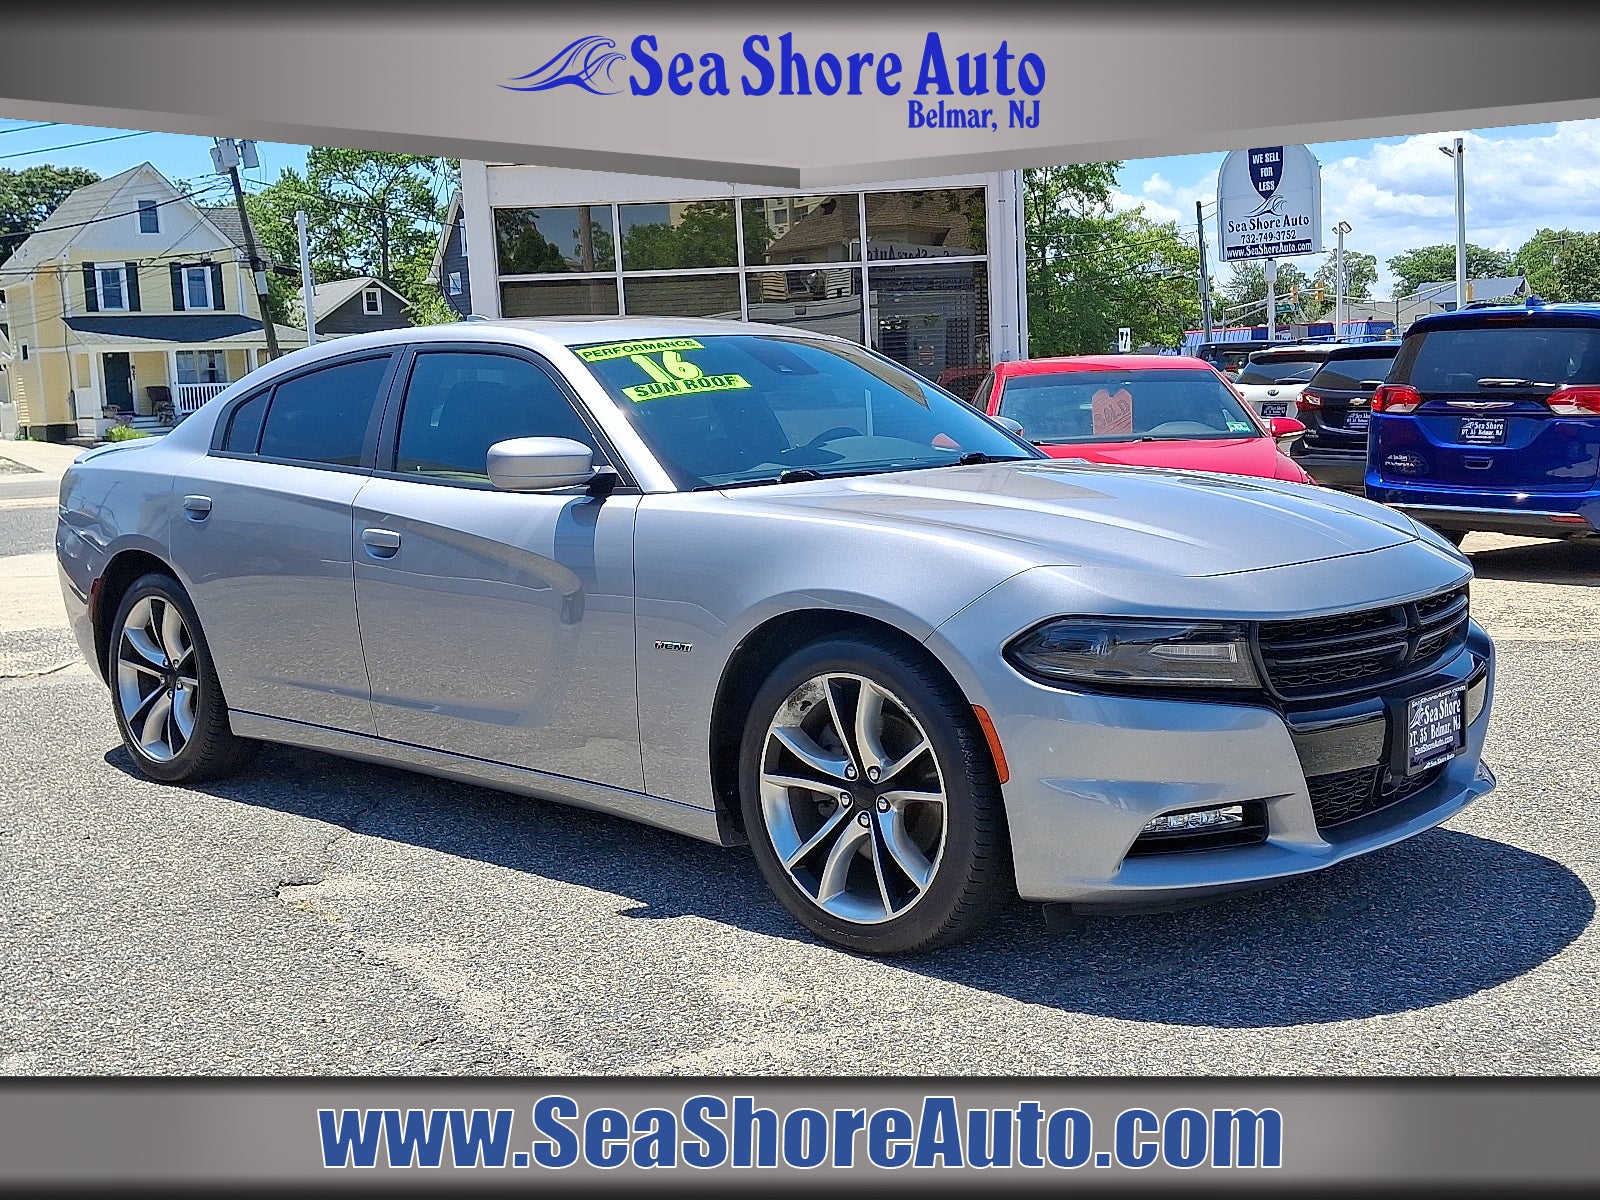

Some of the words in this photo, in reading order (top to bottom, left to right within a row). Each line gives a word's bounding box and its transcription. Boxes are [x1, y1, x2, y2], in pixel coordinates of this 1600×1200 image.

[1252, 153, 1264, 165] WE
[1264, 151, 1281, 164] SELL
[1260, 166, 1274, 178] FOR
[1258, 180, 1275, 192] LESS
[1228, 220, 1247, 233] Sea
[1249, 217, 1281, 231] Shore
[1283, 213, 1310, 228] Auto
[1240, 229, 1297, 245] 732-749-3752
[1226, 241, 1312, 259] www.SeaShoreAuto.com
[583, 340, 696, 359] PERFORMANCE
[630, 350, 703, 383] 16
[634, 381, 679, 397] SUN
[685, 376, 738, 390] ROOF
[1424, 704, 1439, 725] Sea
[1439, 697, 1461, 720] Shore
[1419, 727, 1428, 744] 35
